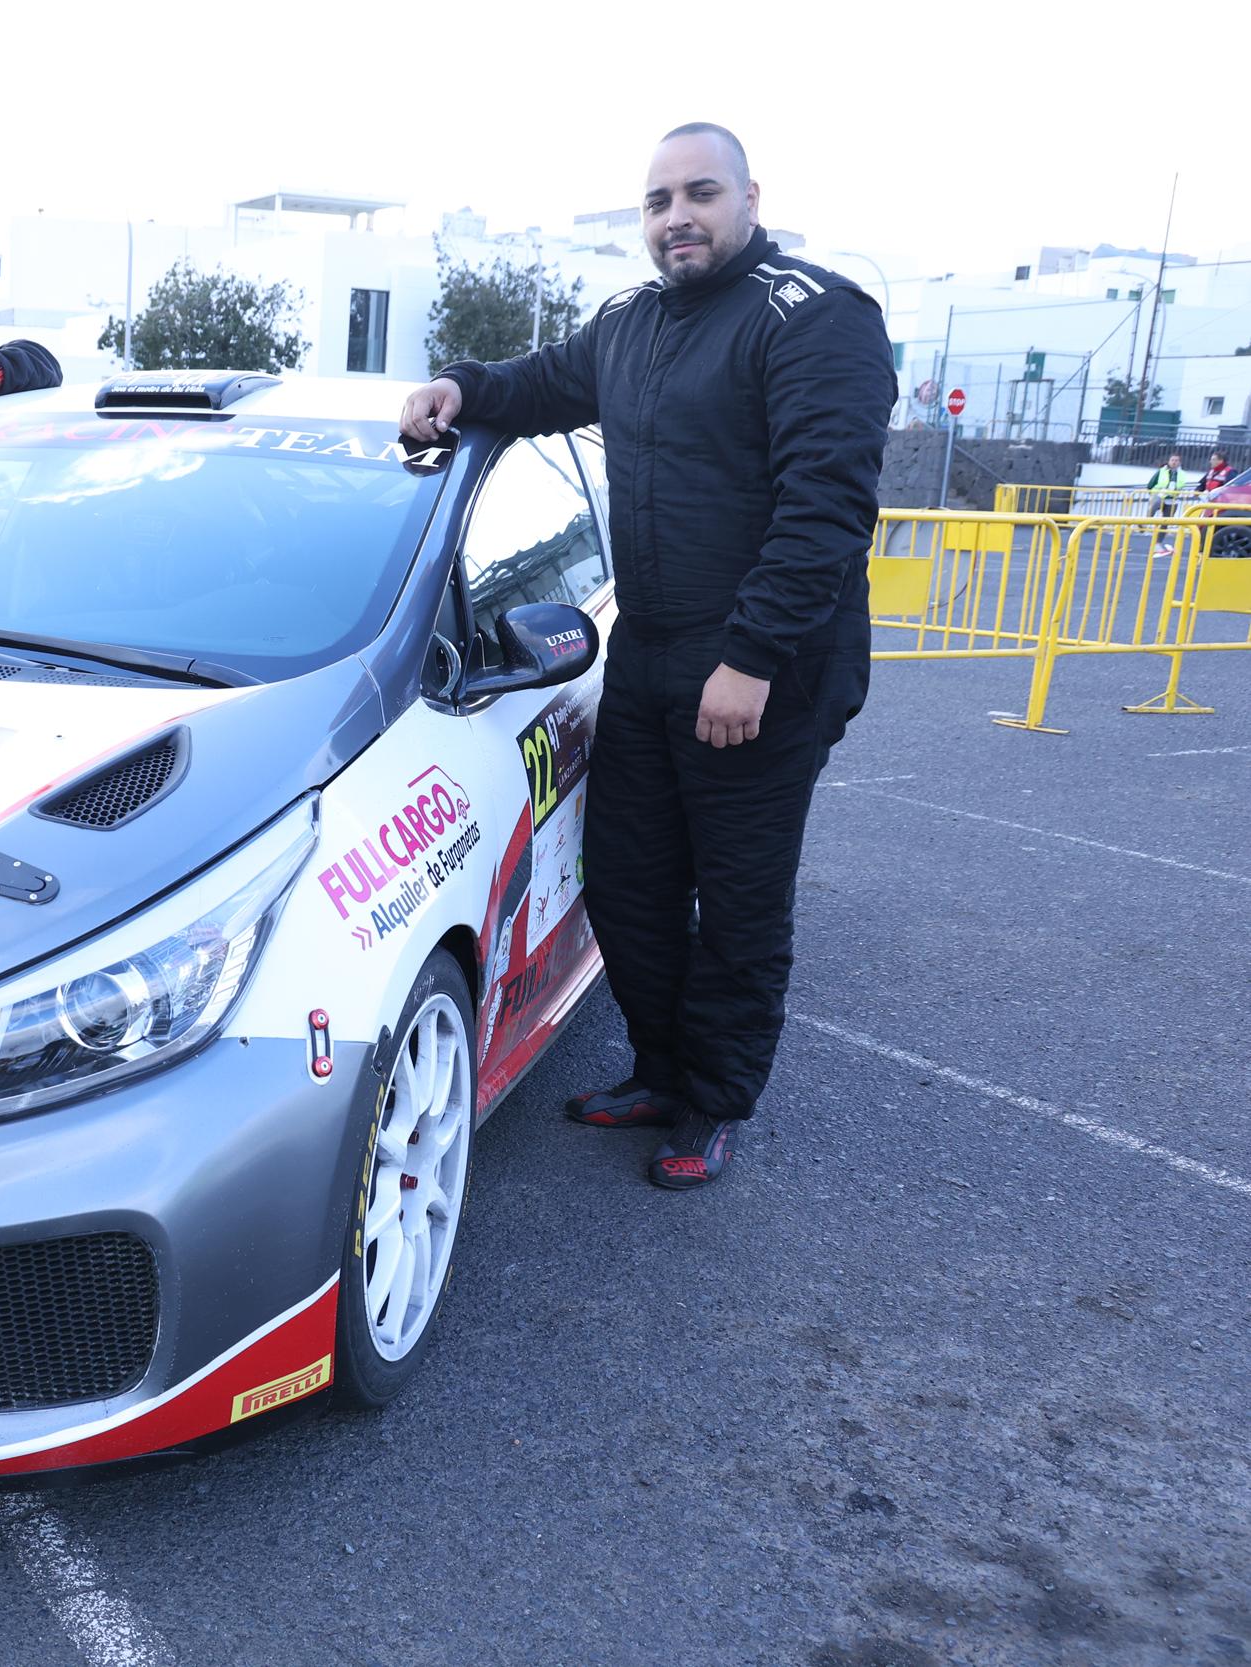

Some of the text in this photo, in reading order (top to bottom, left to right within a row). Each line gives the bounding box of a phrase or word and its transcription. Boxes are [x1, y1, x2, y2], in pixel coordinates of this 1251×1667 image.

[778, 282, 805, 303] OMP
[949, 397, 966, 406] STOP
[236, 427, 451, 468] TEAM
[545, 628, 584, 647] UXIRI
[551, 640, 588, 657] TEAM
[523, 726, 557, 827] 22
[318, 783, 457, 920] FULLCARGO
[371, 868, 440, 940] Alquiler
[426, 861, 445, 888] de
[437, 821, 481, 876] Furgonetas
[661, 1159, 708, 1174] OMP
[241, 1363, 323, 1415] PIRELLI
